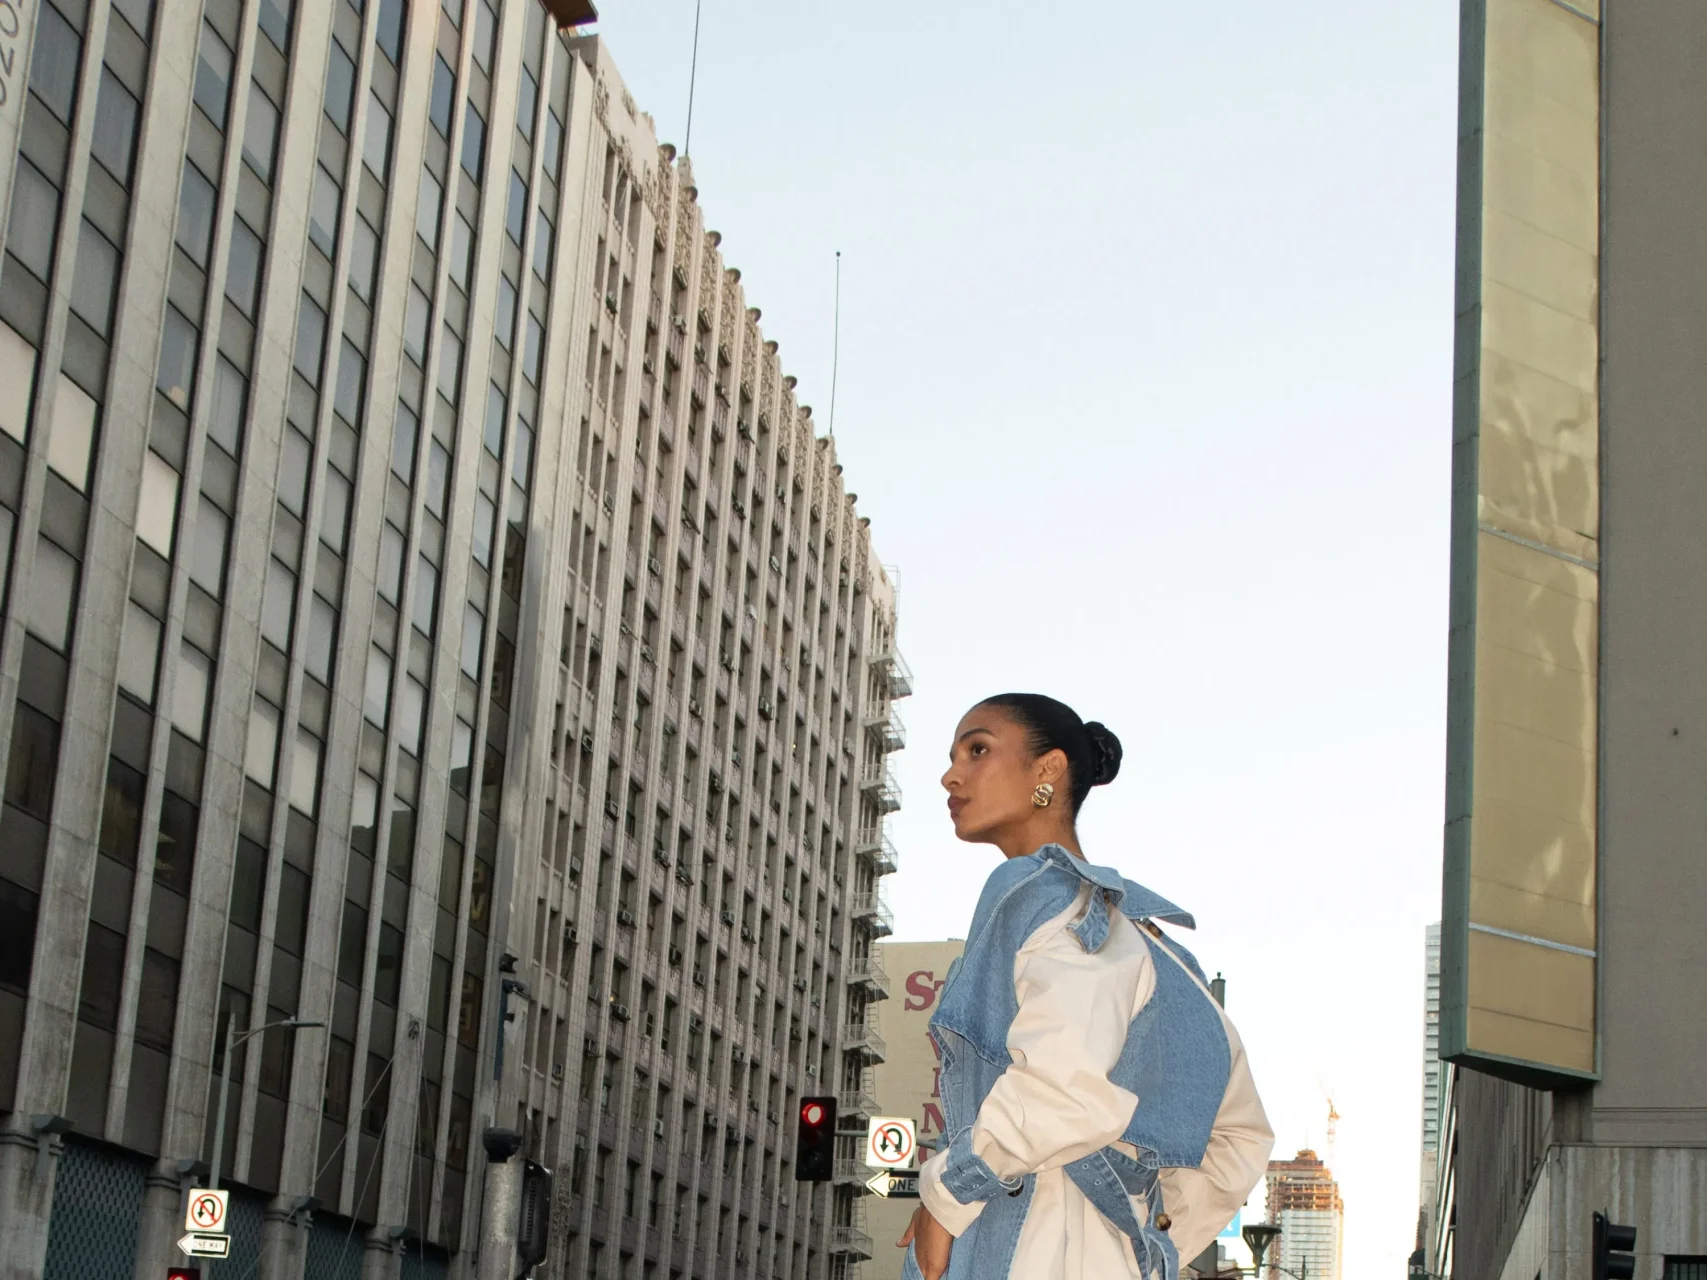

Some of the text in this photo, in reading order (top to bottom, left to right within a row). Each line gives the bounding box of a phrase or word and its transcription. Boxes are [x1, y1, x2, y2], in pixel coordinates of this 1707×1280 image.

[888, 1179, 916, 1191] ONE
[193, 1240, 223, 1249] ONE WAY
